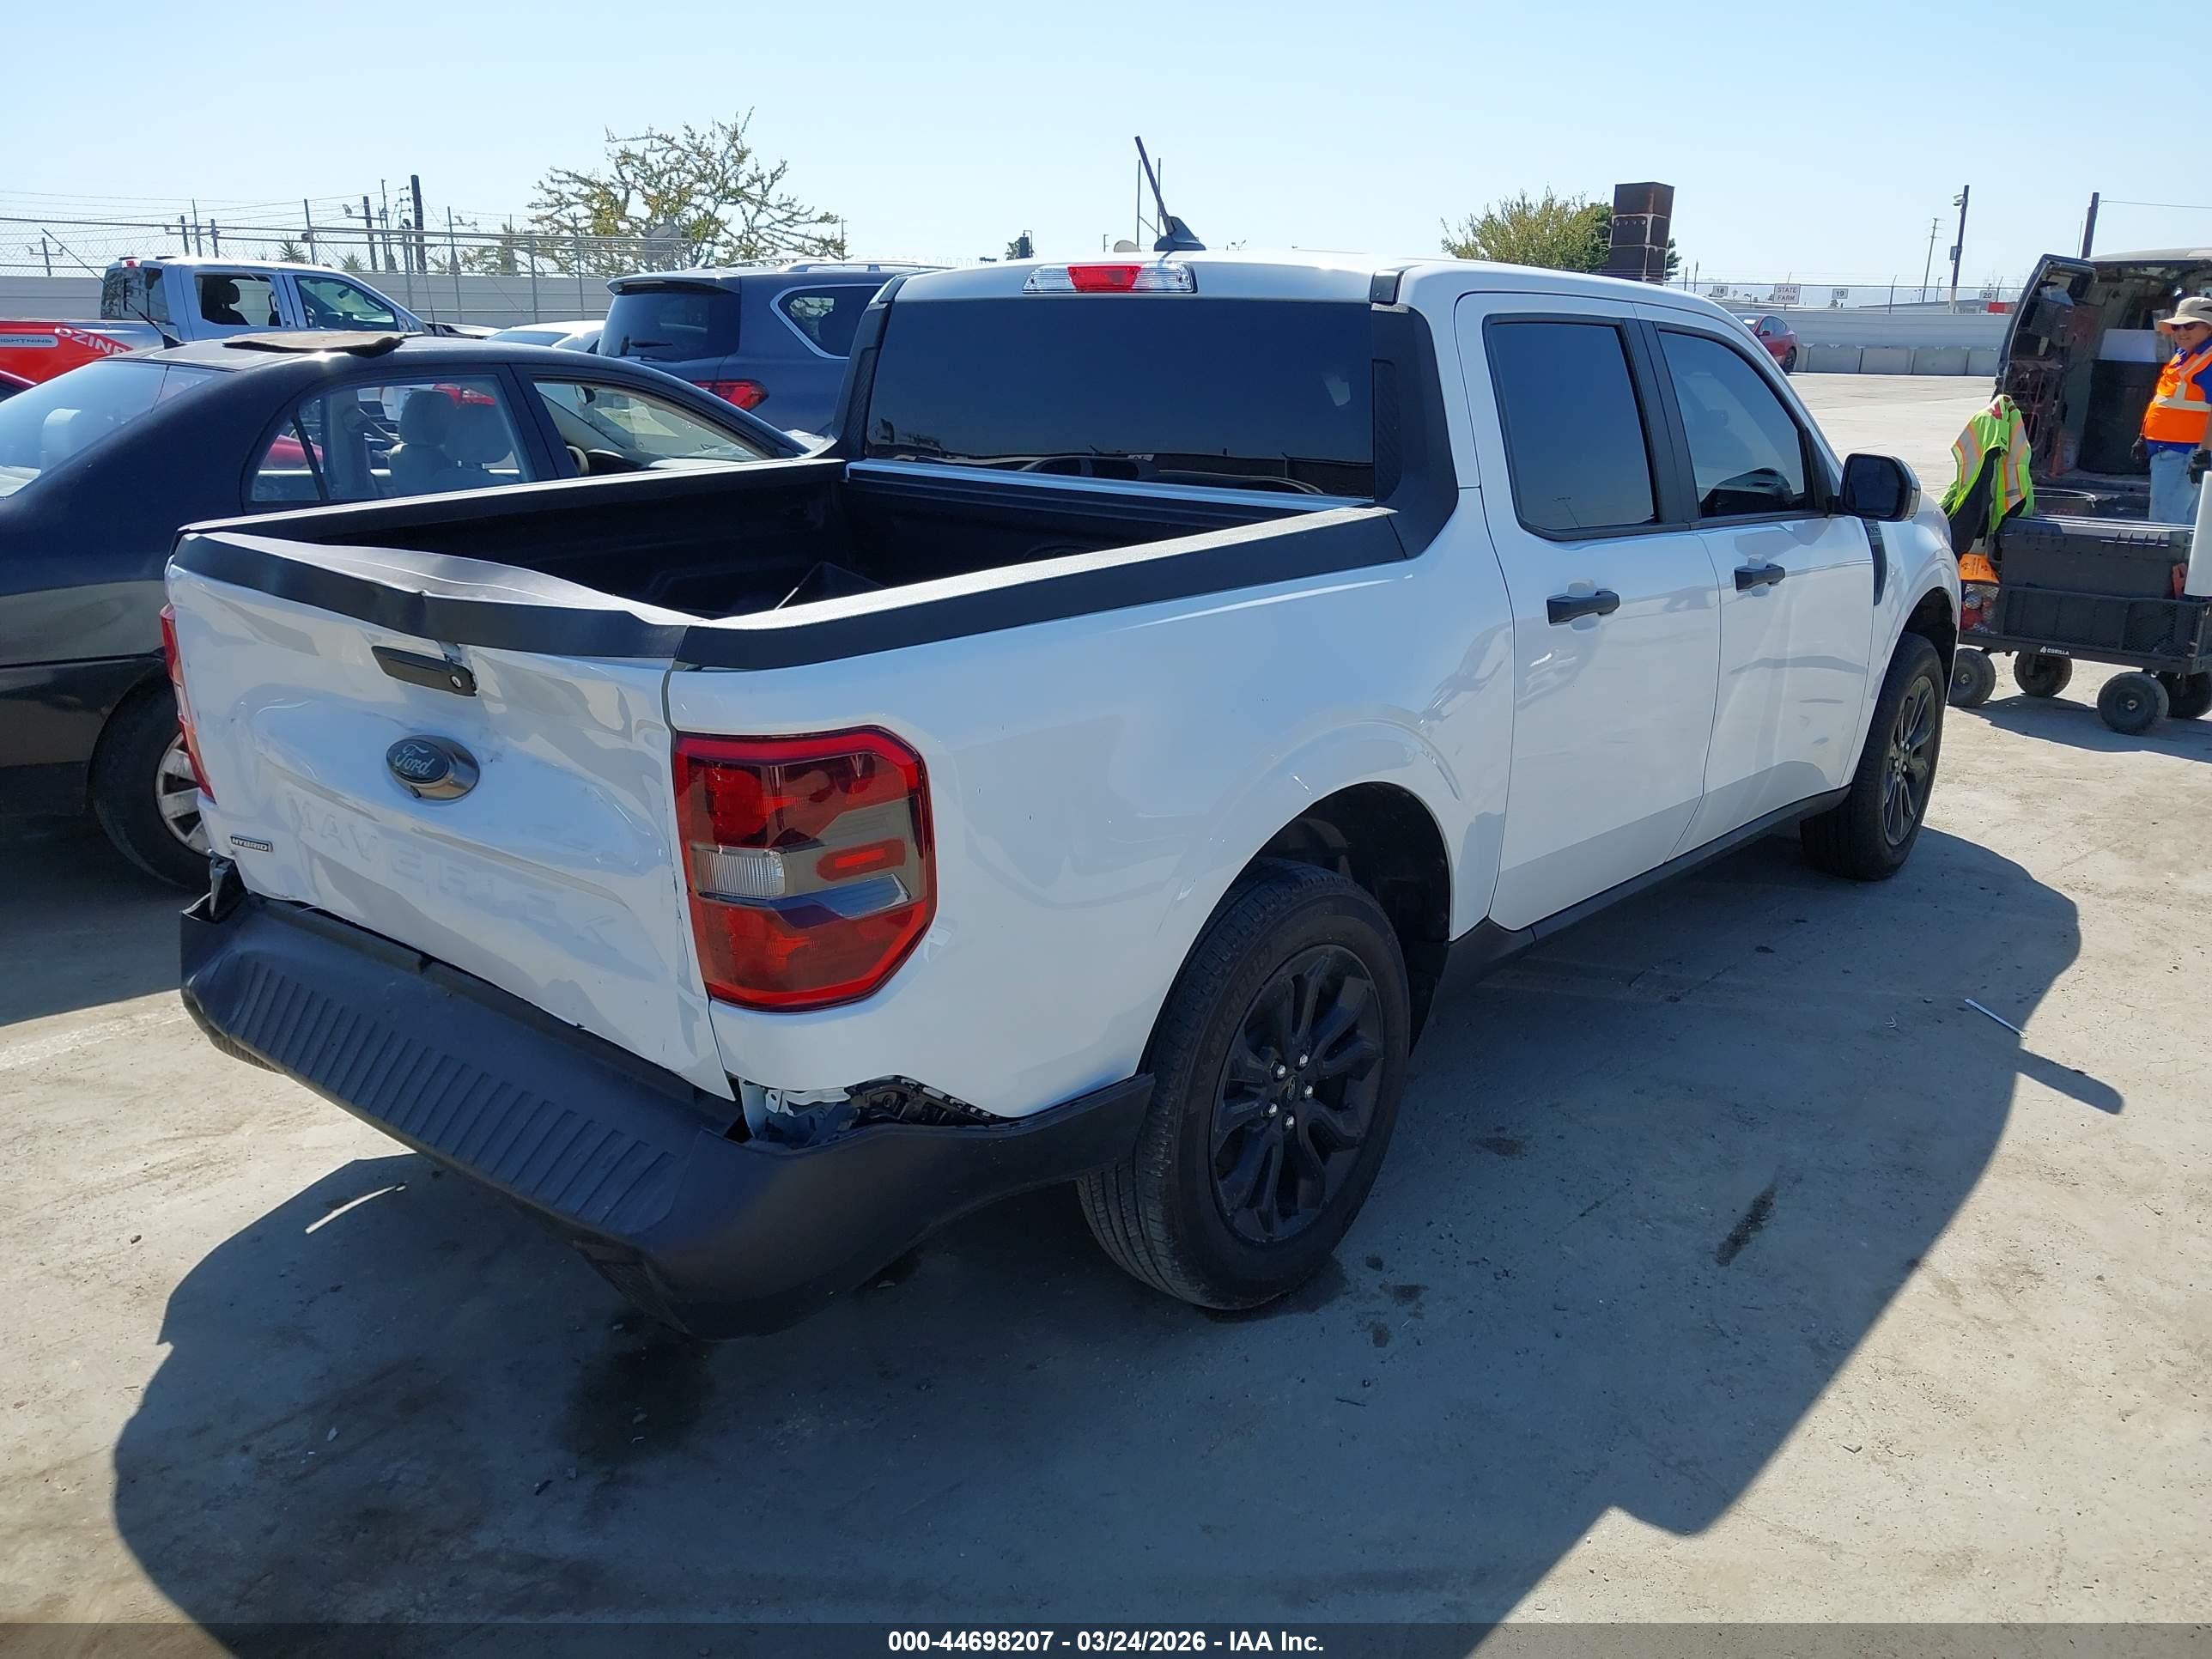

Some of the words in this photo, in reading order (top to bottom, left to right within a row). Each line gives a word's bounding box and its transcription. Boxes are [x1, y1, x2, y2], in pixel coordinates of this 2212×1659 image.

[2047, 647, 2069, 656] GORILLA
[395, 744, 435, 775] Ford
[232, 837, 268, 851] HYBRID
